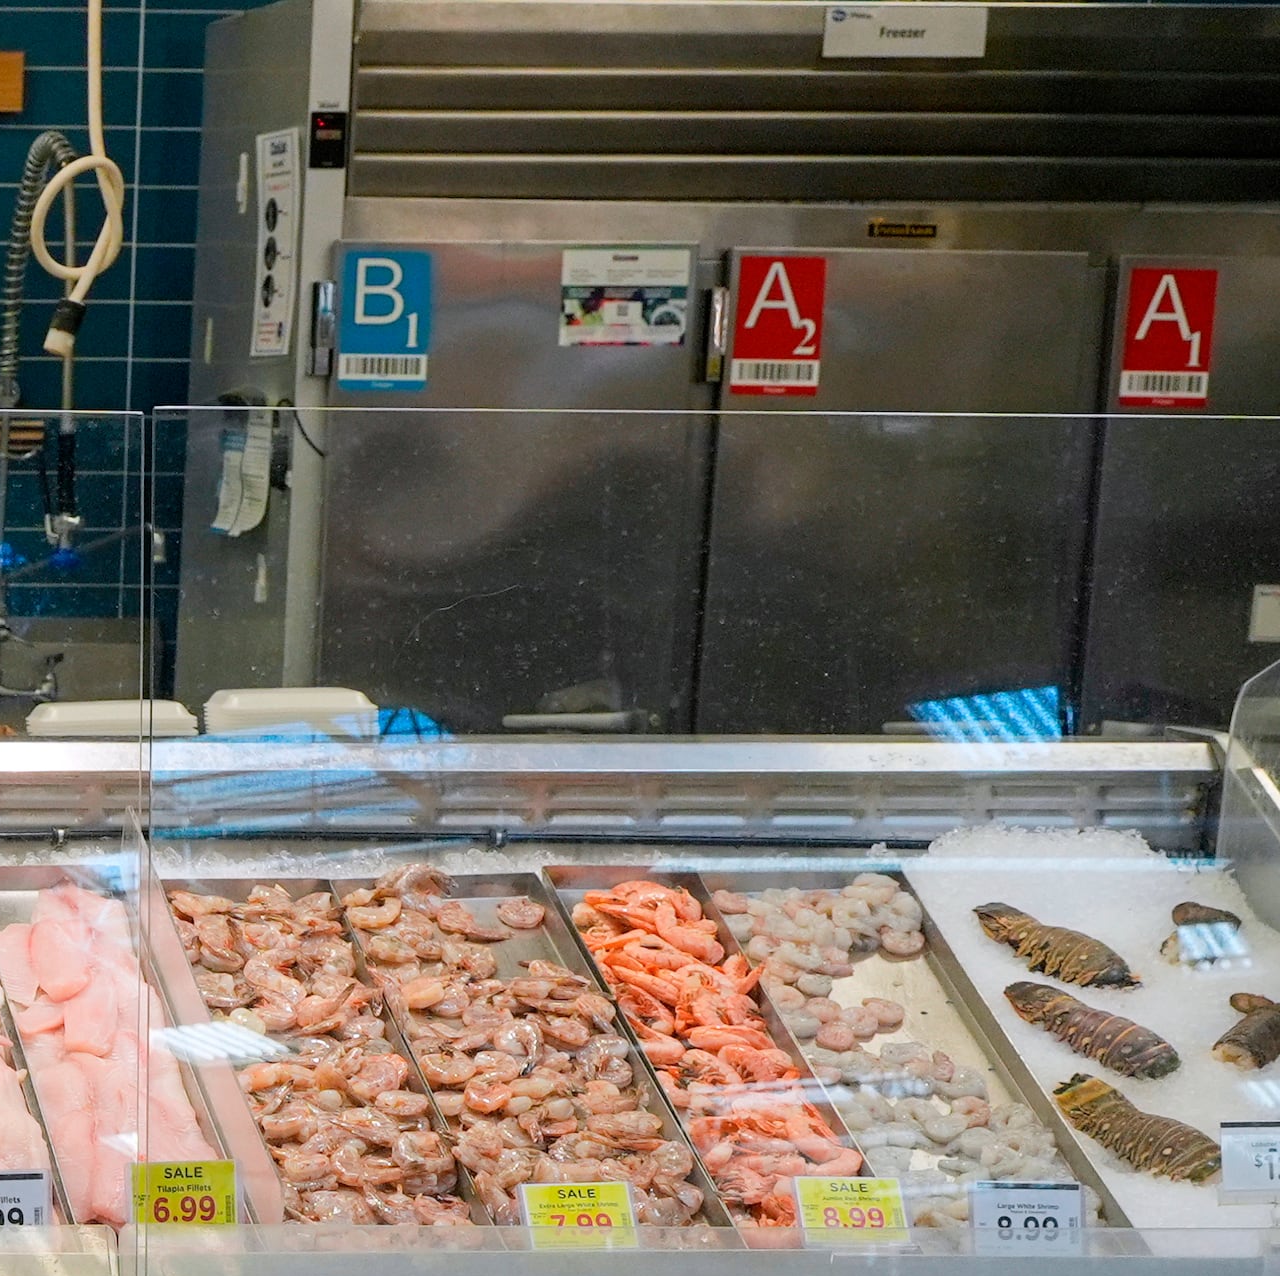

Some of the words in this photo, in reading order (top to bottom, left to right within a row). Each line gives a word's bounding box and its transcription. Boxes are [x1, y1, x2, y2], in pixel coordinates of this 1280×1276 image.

[879, 27, 927, 39] Freezer
[164, 1167, 203, 1179] SALE
[157, 1185, 184, 1193] Tilapia
[830, 1183, 869, 1192] SALE
[558, 1189, 597, 1199] SALE
[153, 1195, 216, 1223] 6.99
[823, 1207, 885, 1228] 8.99
[997, 1216, 1060, 1241] 8.99
